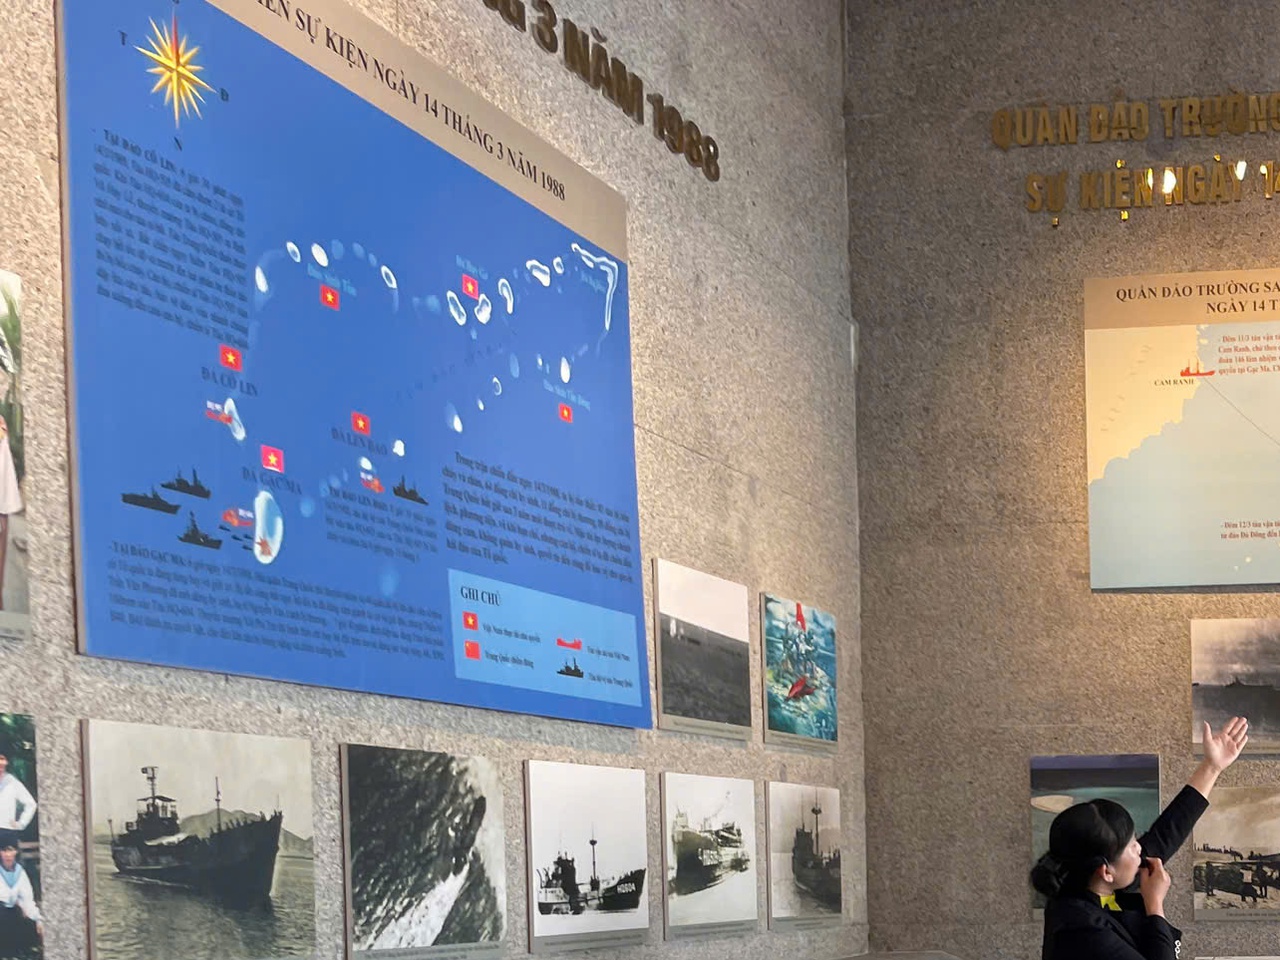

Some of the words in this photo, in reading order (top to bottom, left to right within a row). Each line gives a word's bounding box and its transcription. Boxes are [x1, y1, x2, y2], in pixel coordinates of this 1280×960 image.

[295, 7, 322, 44] SỰ
[325, 26, 369, 72] KIỆN
[373, 56, 419, 105] NGÀY
[424, 93, 439, 119] 14
[441, 104, 494, 155] THÁNG
[497, 141, 504, 161] 3
[507, 146, 538, 185] NĂM
[541, 171, 566, 201] 1988
[532, 0, 558, 53] 3
[563, 18, 645, 125] NĂM
[647, 92, 720, 182] 1988
[1079, 158, 1153, 222] KIỆN
[1163, 154, 1248, 206] NGÀY
[1116, 283, 1158, 303] QUẦN
[1162, 281, 1193, 299] ĐẢO
[1199, 279, 1260, 297] TRƯỜNG
[1206, 298, 1247, 314] NGÀY
[1252, 299, 1266, 312] 14
[460, 585, 479, 601] GHI
